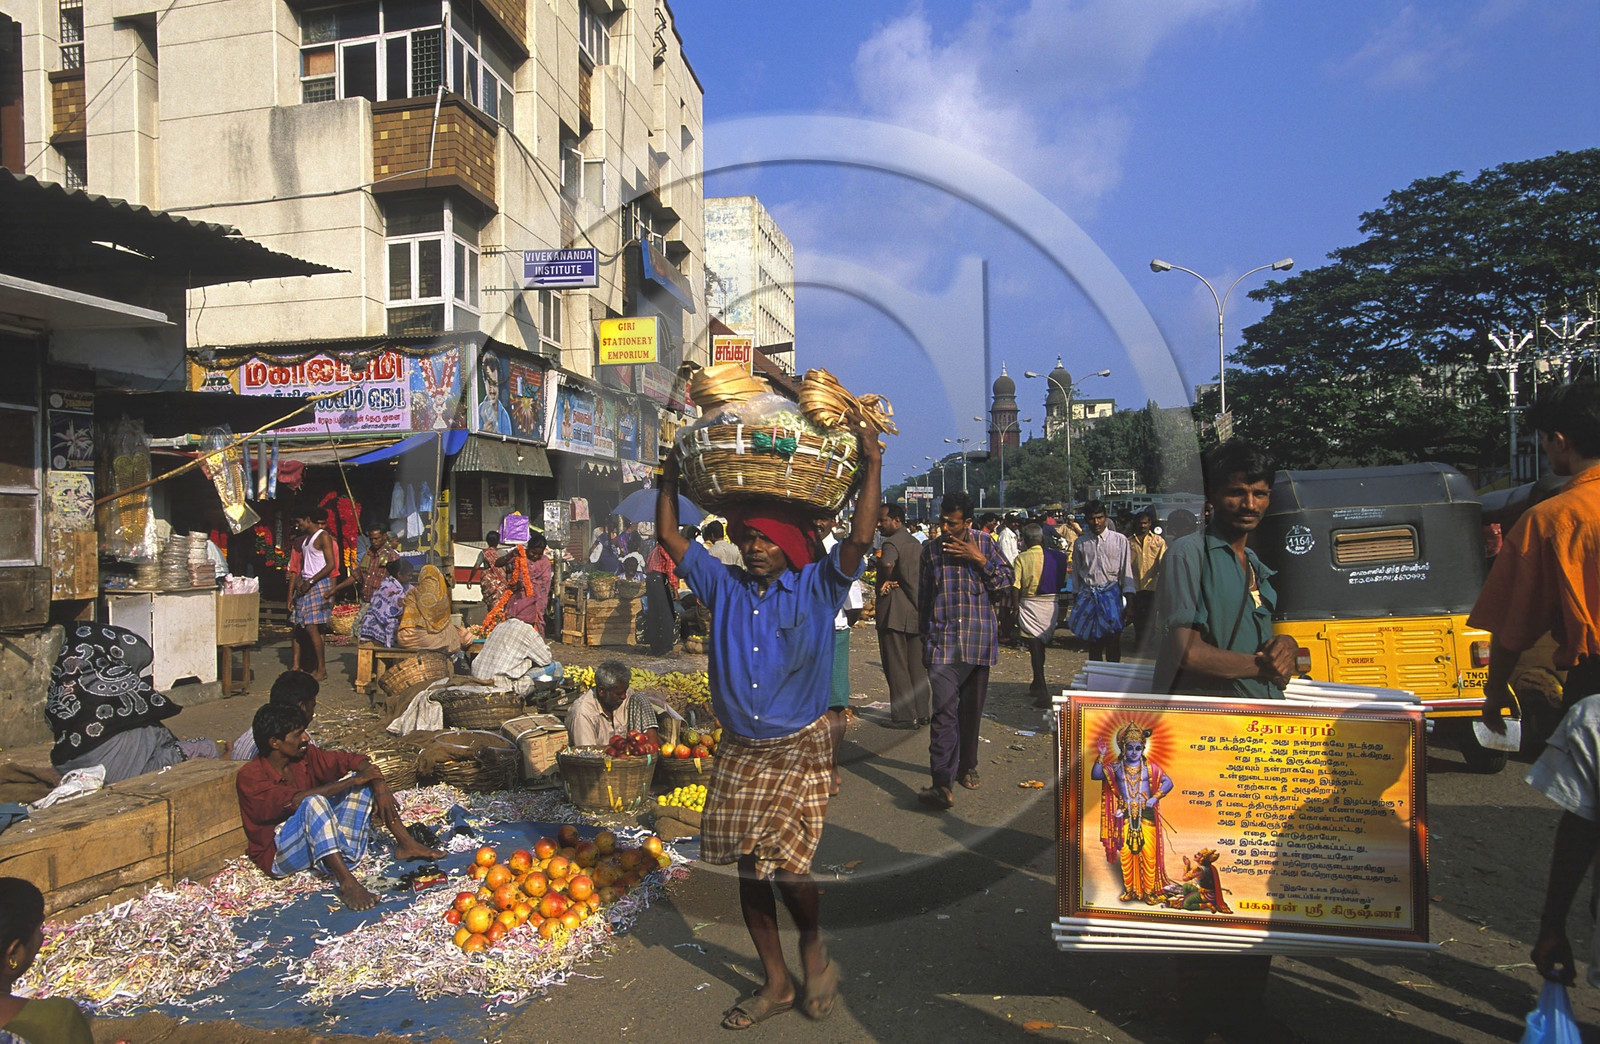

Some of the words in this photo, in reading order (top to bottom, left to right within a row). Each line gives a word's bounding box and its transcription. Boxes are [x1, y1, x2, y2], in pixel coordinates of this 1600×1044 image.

[526, 250, 592, 262] VIVEKANANDA
[536, 265, 582, 275] INSTITUTE
[618, 322, 635, 331] GIRI
[602, 336, 652, 346] STATIONERY
[608, 350, 649, 360] EMPORIUM
[715, 341, 751, 363] சங்கர்
[1246, 720, 1336, 738] கீதாசாரம்
[1294, 738, 1344, 748] நன்றாகவே
[1292, 748, 1343, 757] நன்றாகவே
[1264, 765, 1314, 774] நன்றாகவே
[1292, 776, 1316, 784] எதை
[1236, 783, 1278, 791] எதற்காக
[1281, 784, 1288, 792] நீ
[1218, 790, 1260, 800] கொண்டு
[1240, 838, 1282, 848] இங்கேயே
[1230, 848, 1246, 856] எது
[1250, 848, 1278, 858] இன்று
[1239, 901, 1298, 912] பகவான்
